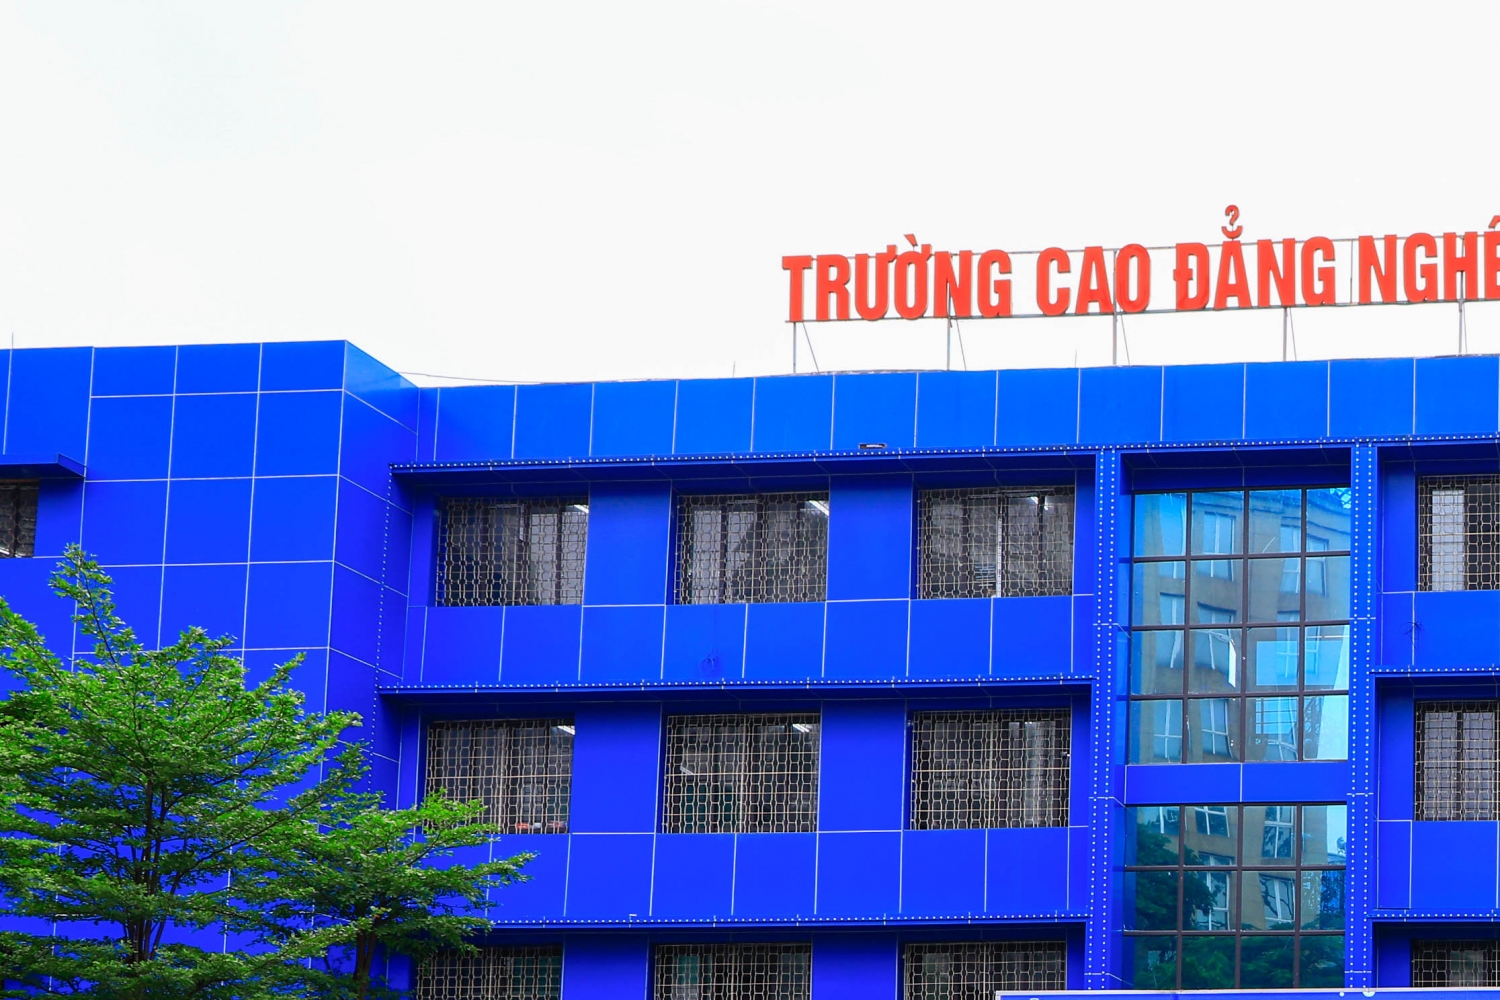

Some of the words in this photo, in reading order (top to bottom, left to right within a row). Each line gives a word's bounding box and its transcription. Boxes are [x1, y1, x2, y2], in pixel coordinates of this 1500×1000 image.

[781, 234, 1012, 321] TRƯỜNG
[1035, 242, 1152, 317] CAO
[1172, 204, 1337, 312] ĐẲNG
